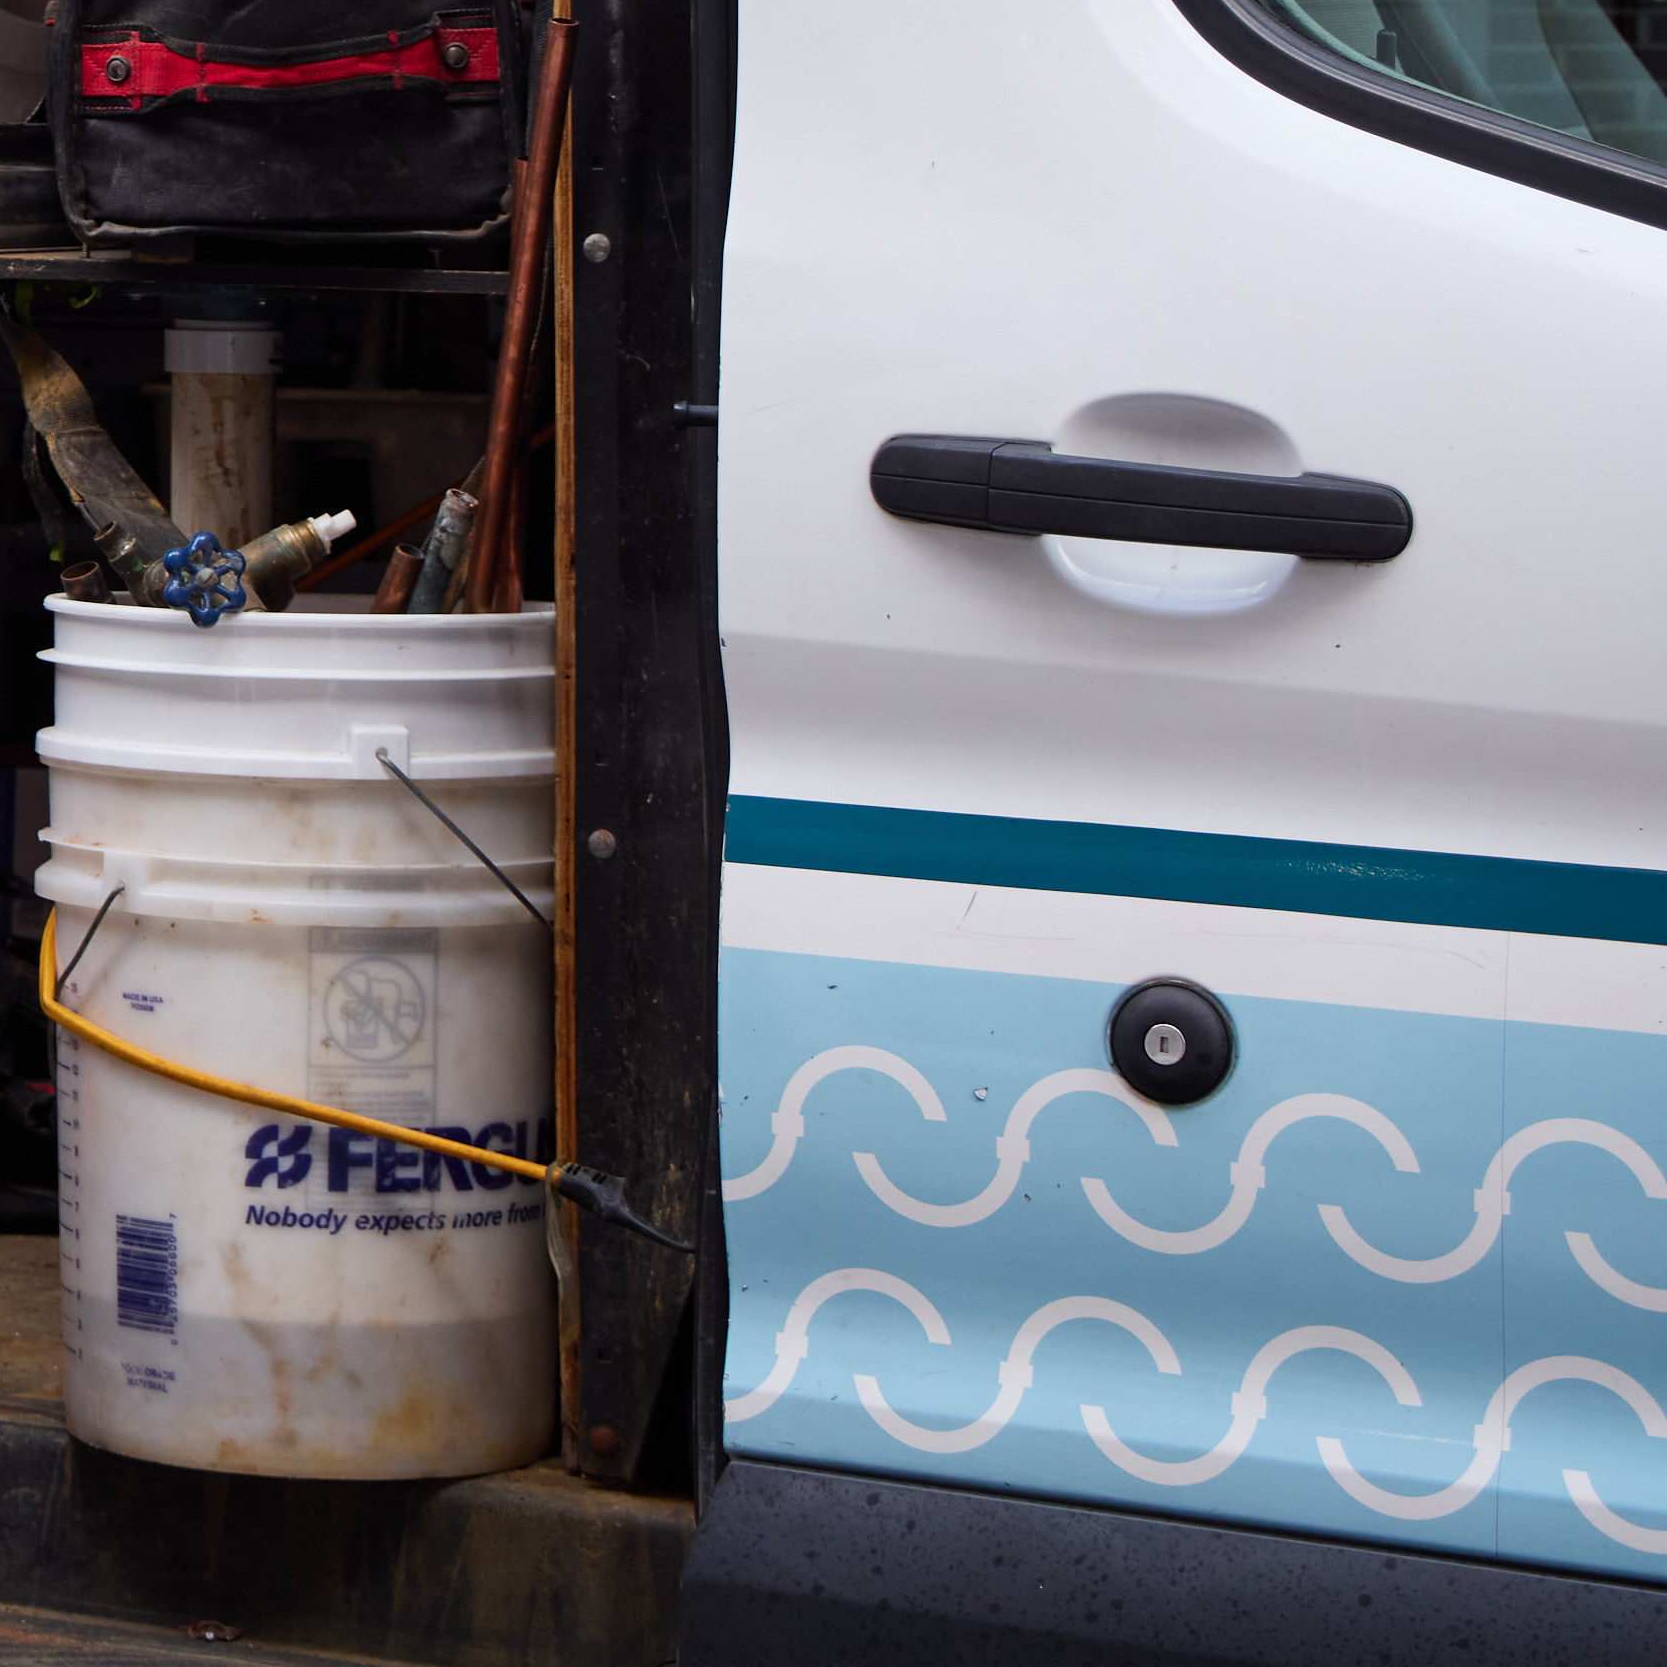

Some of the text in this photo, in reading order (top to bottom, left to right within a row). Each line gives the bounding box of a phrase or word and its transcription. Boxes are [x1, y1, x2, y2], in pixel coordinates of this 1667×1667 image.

[244, 1204, 348, 1235] Nobody
[354, 1211, 447, 1236] expects
[452, 1209, 503, 1229] more
[508, 1201, 541, 1225] from
